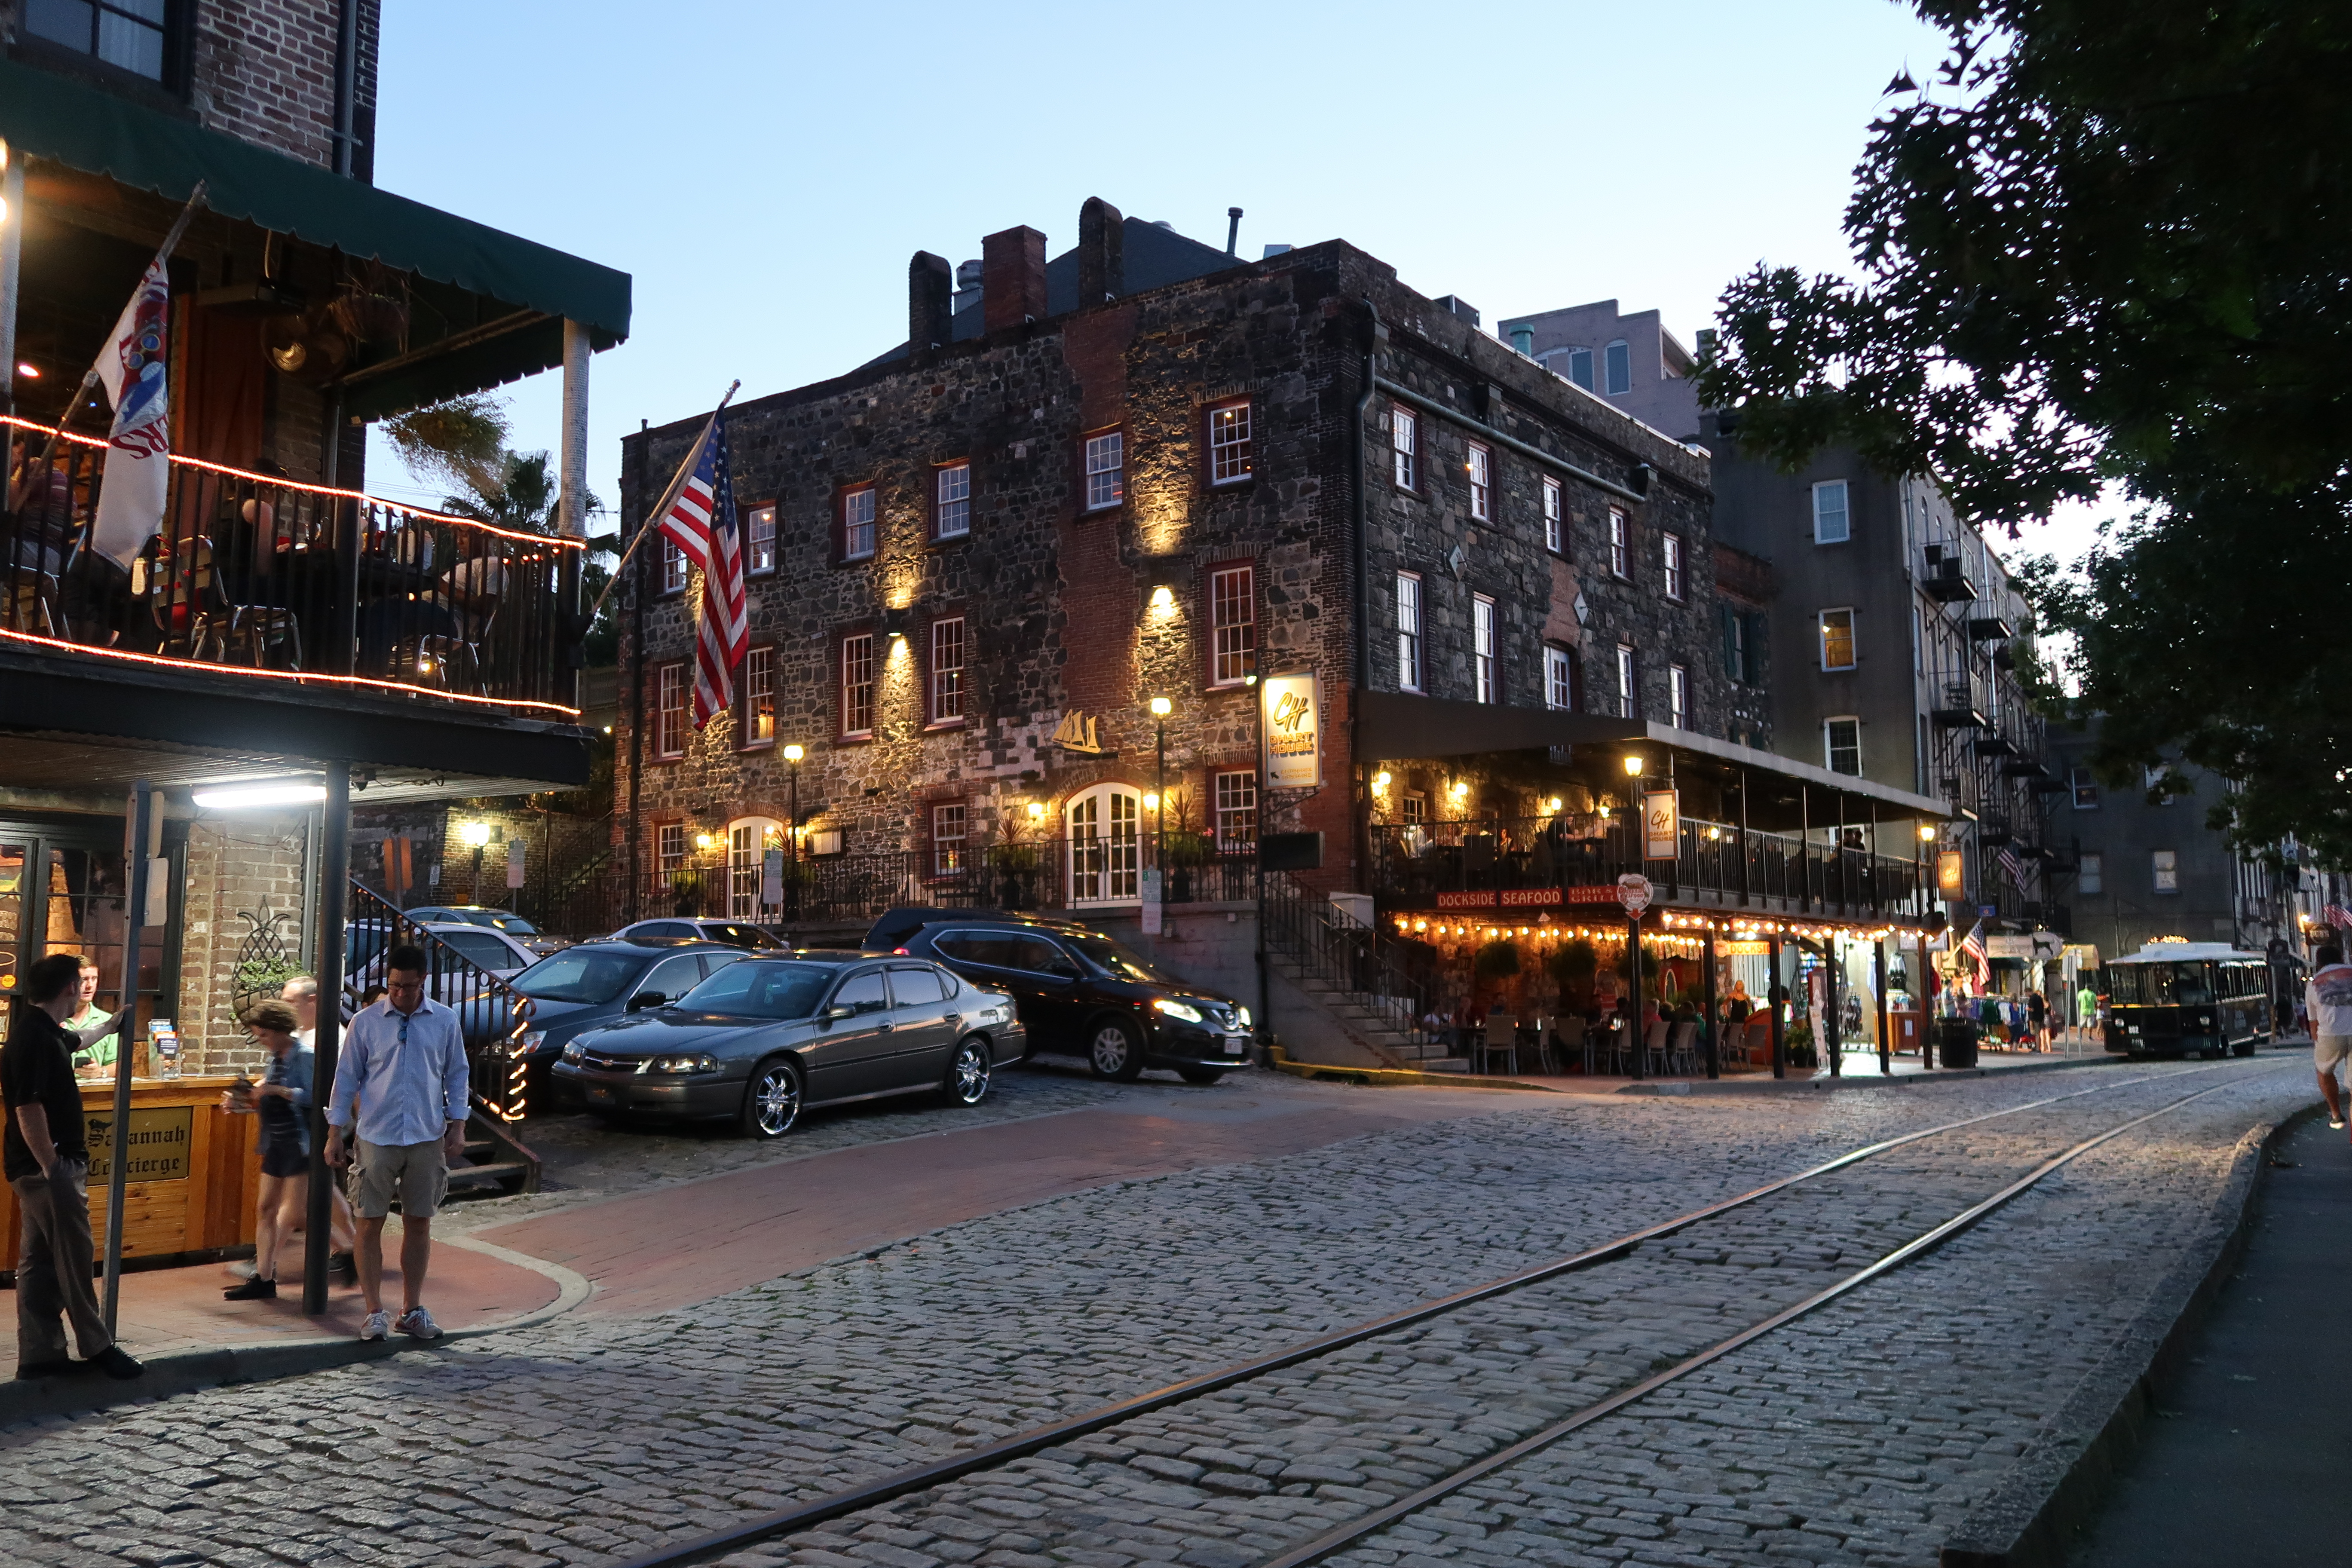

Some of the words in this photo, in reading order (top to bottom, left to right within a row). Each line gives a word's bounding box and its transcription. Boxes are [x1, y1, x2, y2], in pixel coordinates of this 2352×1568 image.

[1270, 731, 1314, 744] CHART
[1270, 741, 1314, 756] HOUSE
[1651, 810, 1670, 829] CH
[1439, 893, 1495, 906] DOCKSIDE
[1503, 890, 1561, 905] SEAFOOD
[88, 1125, 185, 1147] Saannah
[88, 1158, 180, 1176] Cocierge
